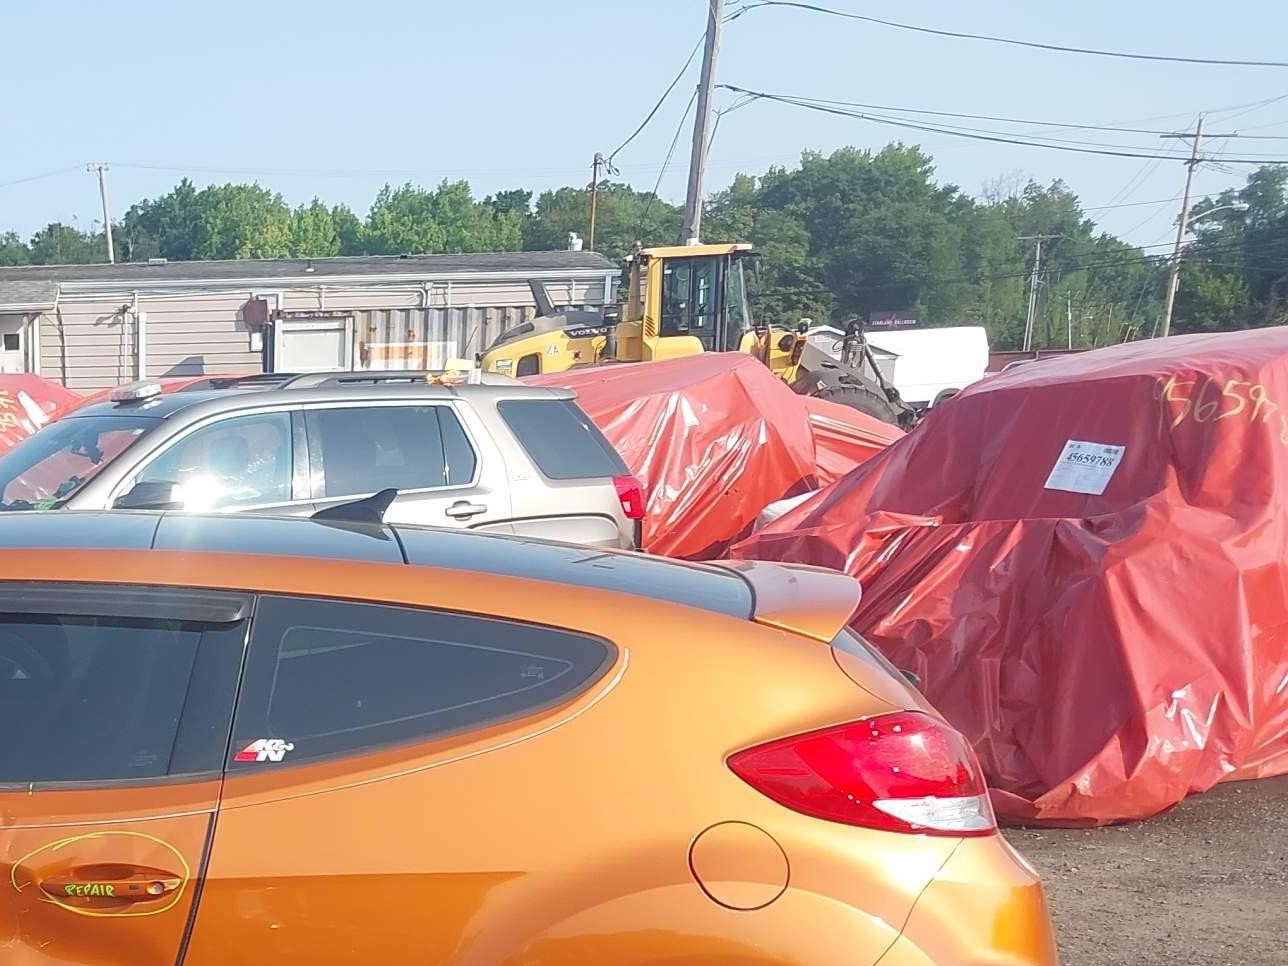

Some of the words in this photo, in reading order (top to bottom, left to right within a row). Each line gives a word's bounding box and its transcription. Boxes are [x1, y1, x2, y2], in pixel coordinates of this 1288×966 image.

[569, 327, 608, 336] VOLVO
[1066, 452, 1114, 467] 45659788
[64, 883, 115, 897] REPAIR
